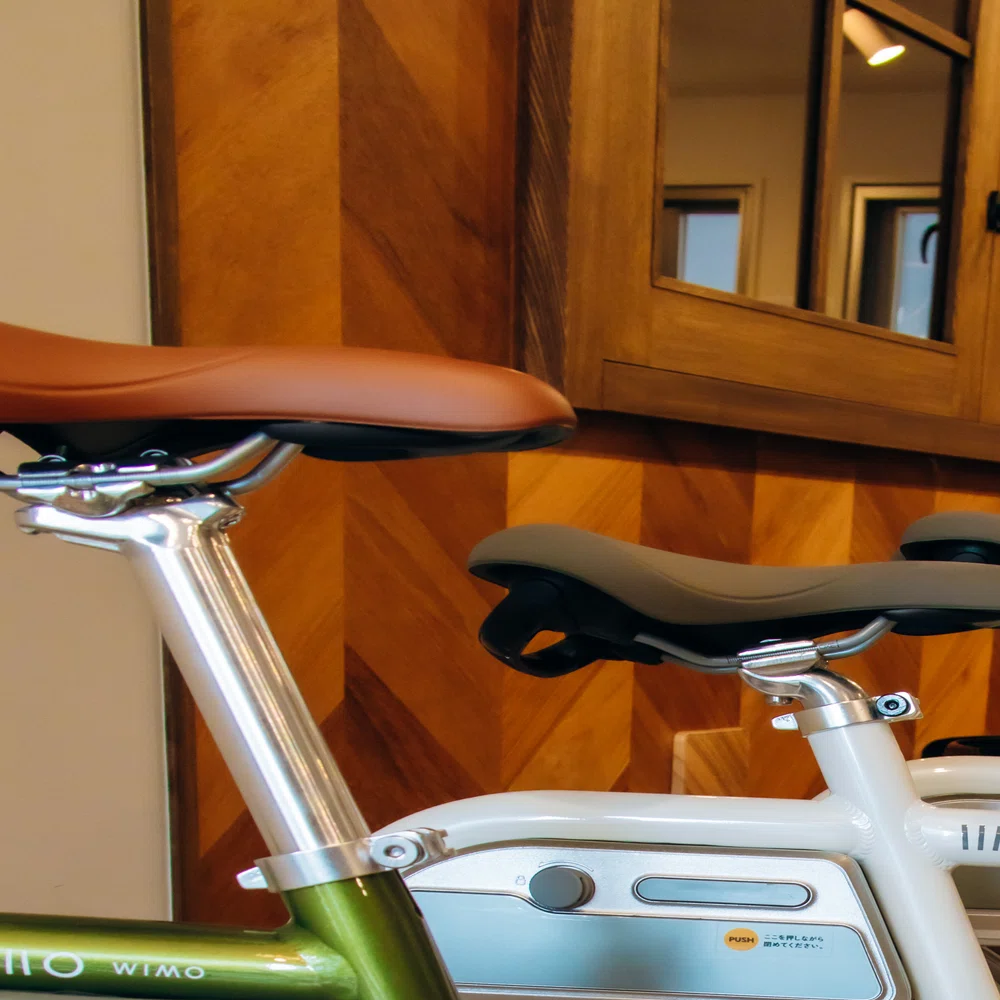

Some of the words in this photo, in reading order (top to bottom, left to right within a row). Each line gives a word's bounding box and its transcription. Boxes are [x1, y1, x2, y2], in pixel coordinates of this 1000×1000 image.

[764, 934, 824, 942] ここを押しながら
[112, 961, 205, 979] WIMO
